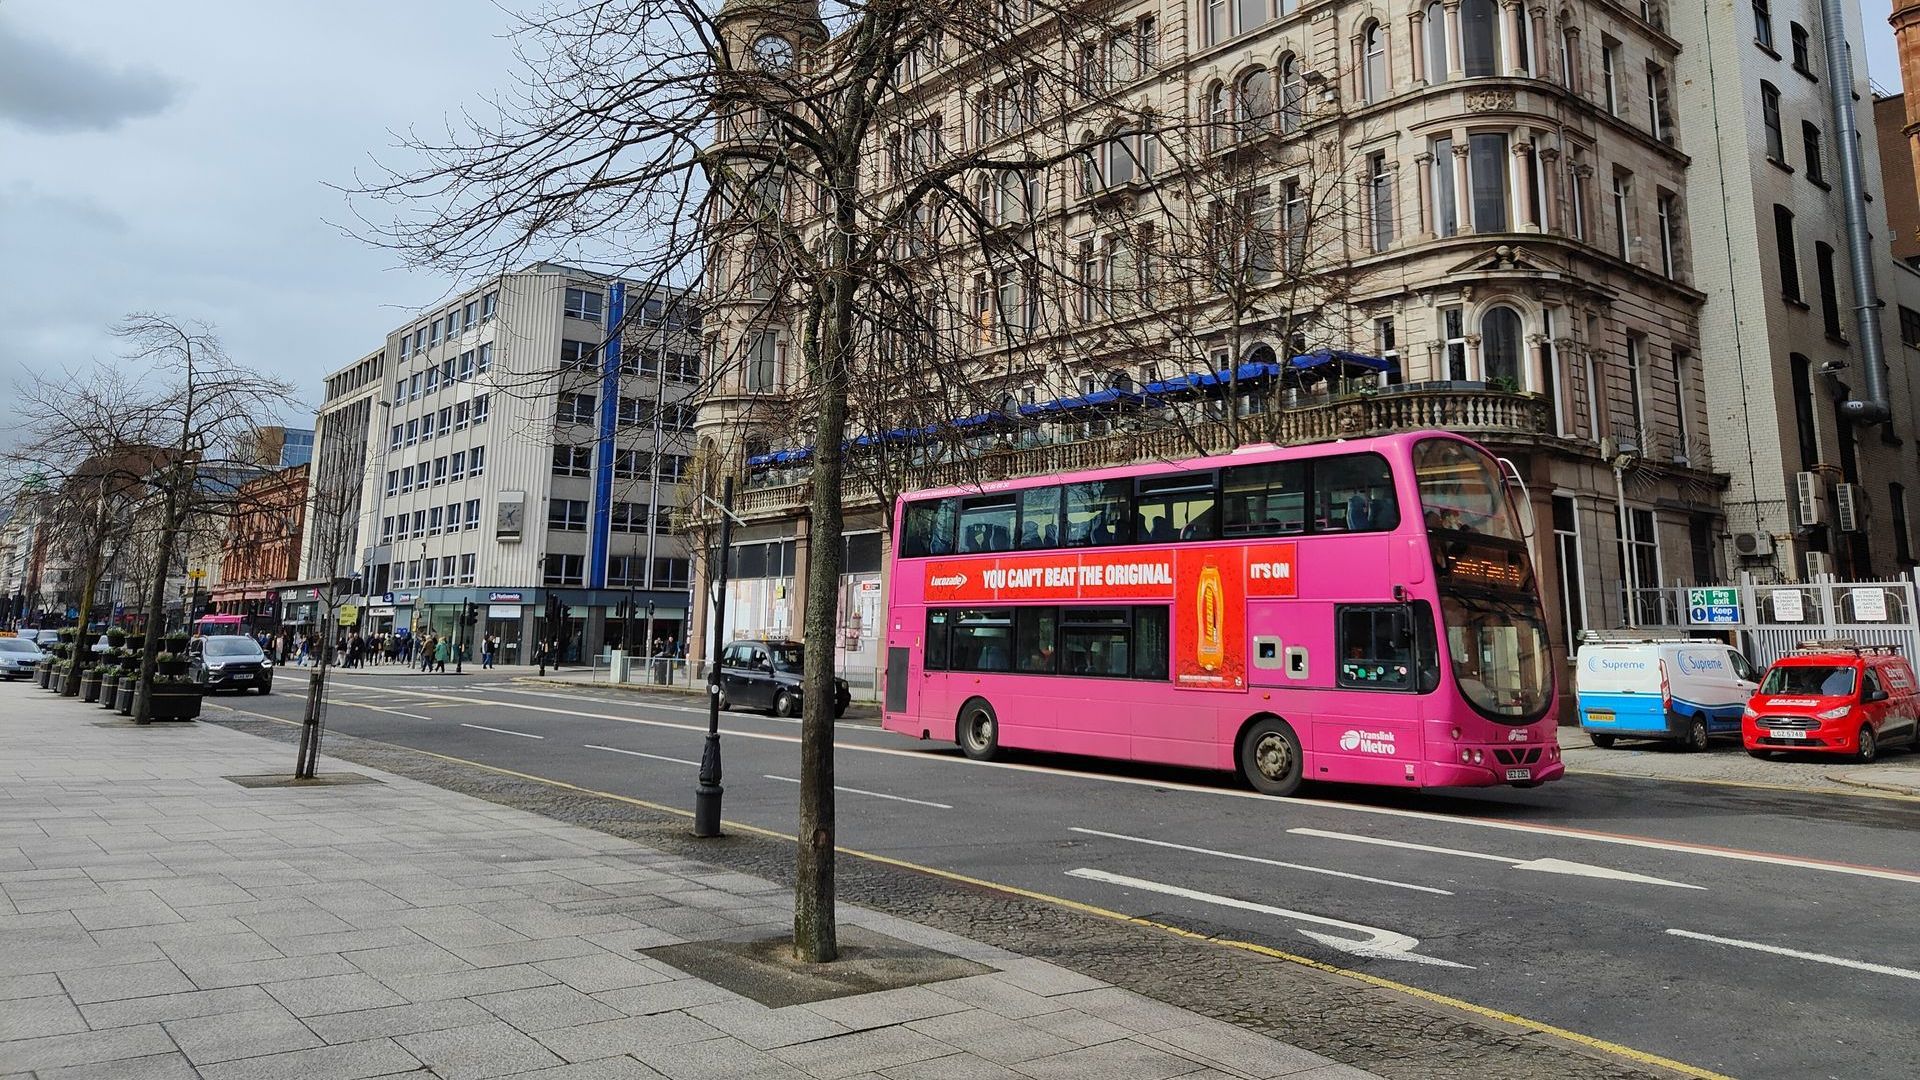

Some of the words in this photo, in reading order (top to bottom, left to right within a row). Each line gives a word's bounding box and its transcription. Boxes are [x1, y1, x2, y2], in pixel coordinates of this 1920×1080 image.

[983, 569, 1006, 588] YOU
[1007, 568, 1043, 588] CAN'T
[1044, 567, 1077, 587] BEAT
[1079, 566, 1103, 586] THE
[1105, 563, 1172, 585] ORIGINAL
[1250, 563, 1271, 578] IT'S
[1272, 562, 1290, 578] ON
[931, 575, 963, 586] Lucozade
[1712, 590, 1729, 598] Fire
[1713, 597, 1730, 605] exit
[1712, 607, 1732, 615] Keep
[1713, 614, 1732, 622] clear
[1602, 660, 1645, 670] Supreme
[1688, 655, 1723, 673] Supreme
[1359, 730, 1395, 741] Translink
[1360, 739, 1396, 755] Metro
